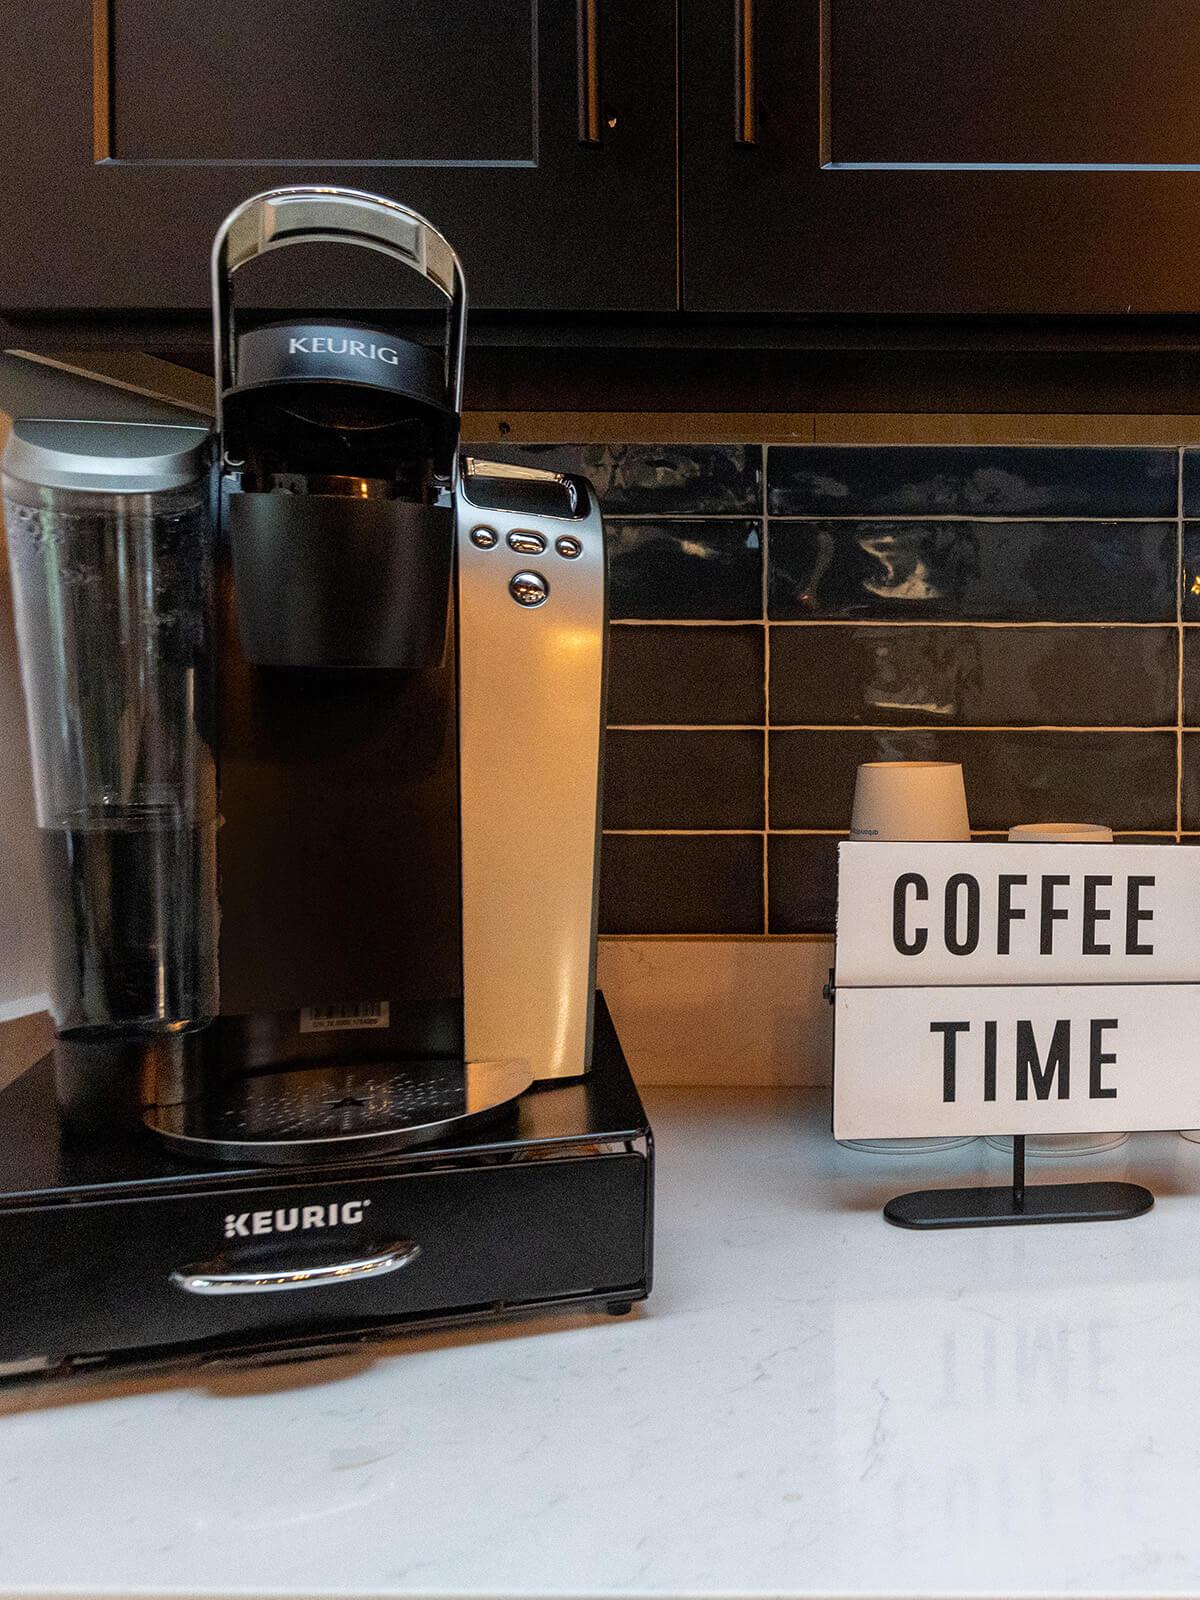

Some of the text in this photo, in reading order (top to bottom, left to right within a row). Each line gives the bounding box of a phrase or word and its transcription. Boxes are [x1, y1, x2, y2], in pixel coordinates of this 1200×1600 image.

[288, 337, 399, 366] KEURIG
[893, 872, 1155, 956] COFFEE
[929, 1018, 1119, 1103] TIME
[224, 1200, 371, 1239] KEURIG
